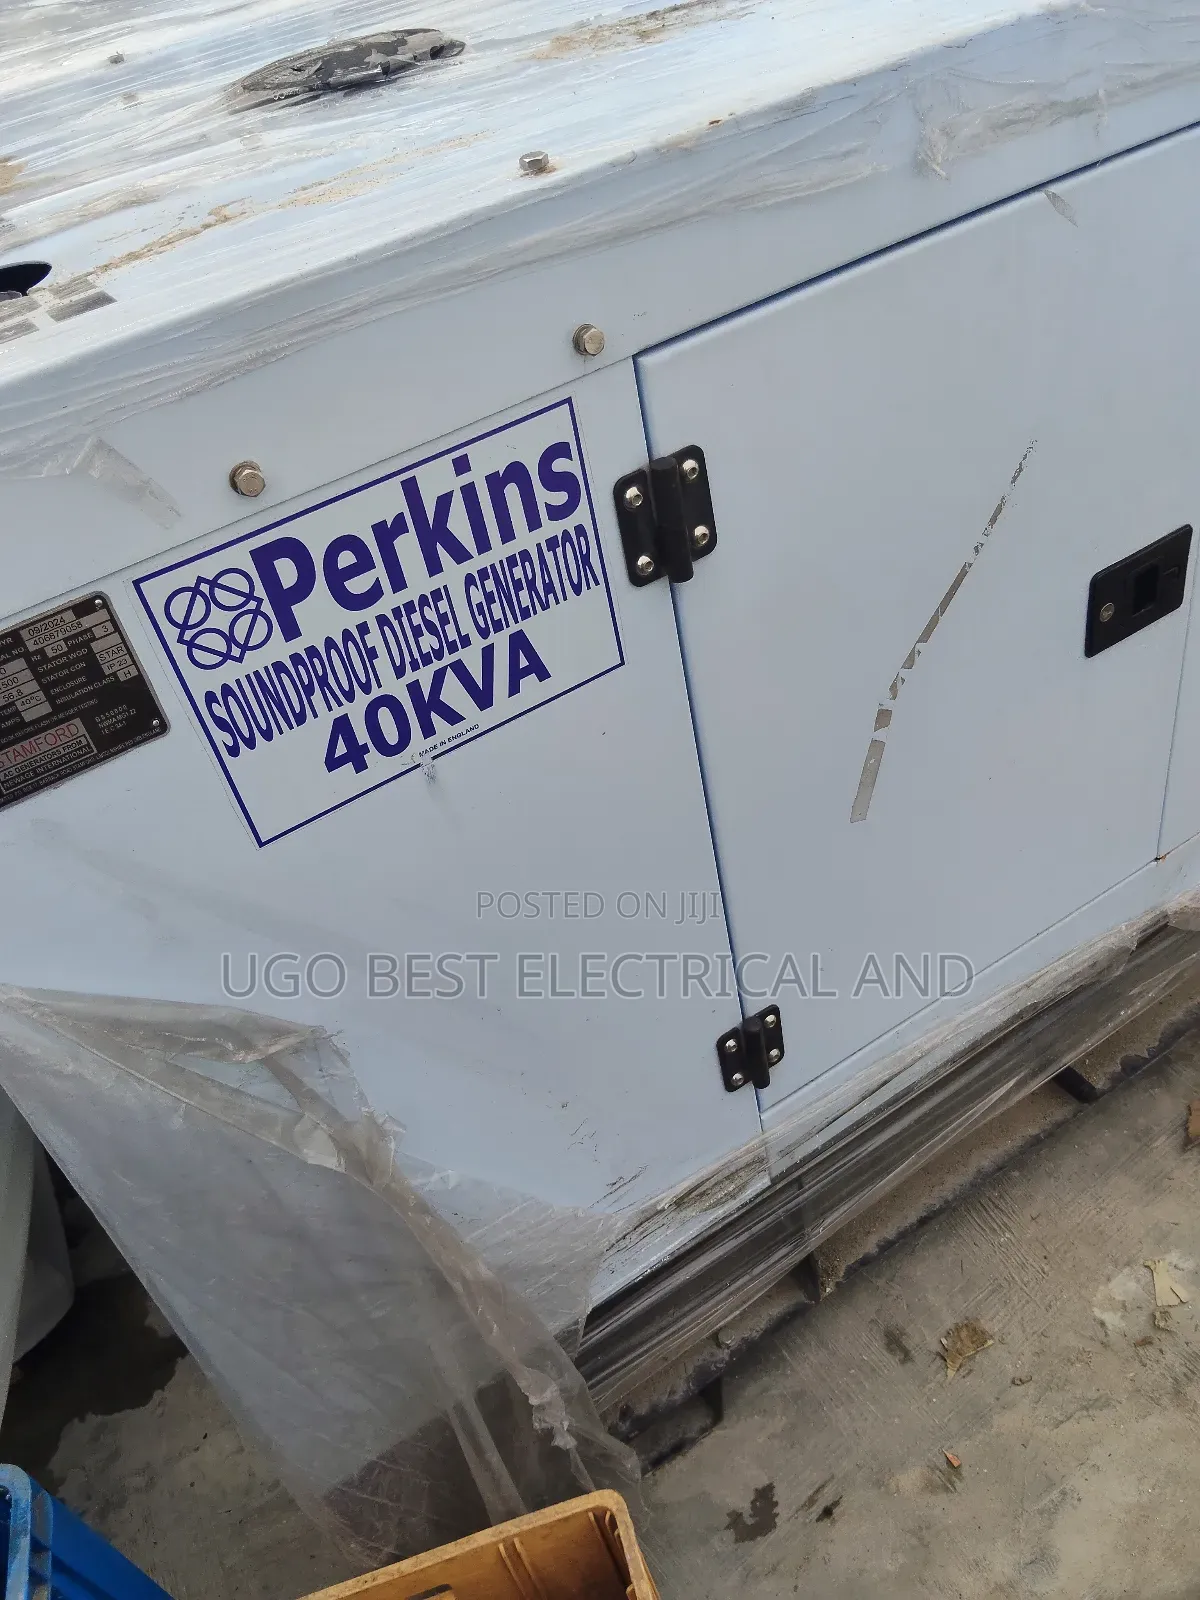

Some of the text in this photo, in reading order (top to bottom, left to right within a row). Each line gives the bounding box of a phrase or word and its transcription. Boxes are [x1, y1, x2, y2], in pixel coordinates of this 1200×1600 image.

[249, 441, 582, 643] Perkins
[28, 616, 66, 637] 09/2024
[51, 644, 63, 655] 50
[67, 632, 94, 647] PHASE
[101, 624, 109, 633] 3
[204, 523, 600, 758] SOUNDPROOF DIESEL GENERATOR
[37, 655, 69, 673] STATOR
[41, 667, 70, 684] STATOR
[99, 646, 125, 662] STAR
[50, 658, 128, 695] ENCLOSURE IP 23
[2, 688, 24, 702] 56.8
[56, 669, 132, 705] INSULATION CLASS H
[323, 628, 551, 775] 40KVA
[418, 723, 480, 758] MADE IN ENGLAND
[3, 770, 14, 780] AC
[14, 750, 62, 774] GENERATORS
[62, 739, 84, 753] FROM
[3, 771, 35, 789] NEWAGE
[36, 746, 93, 774] INTERNATIONAL
